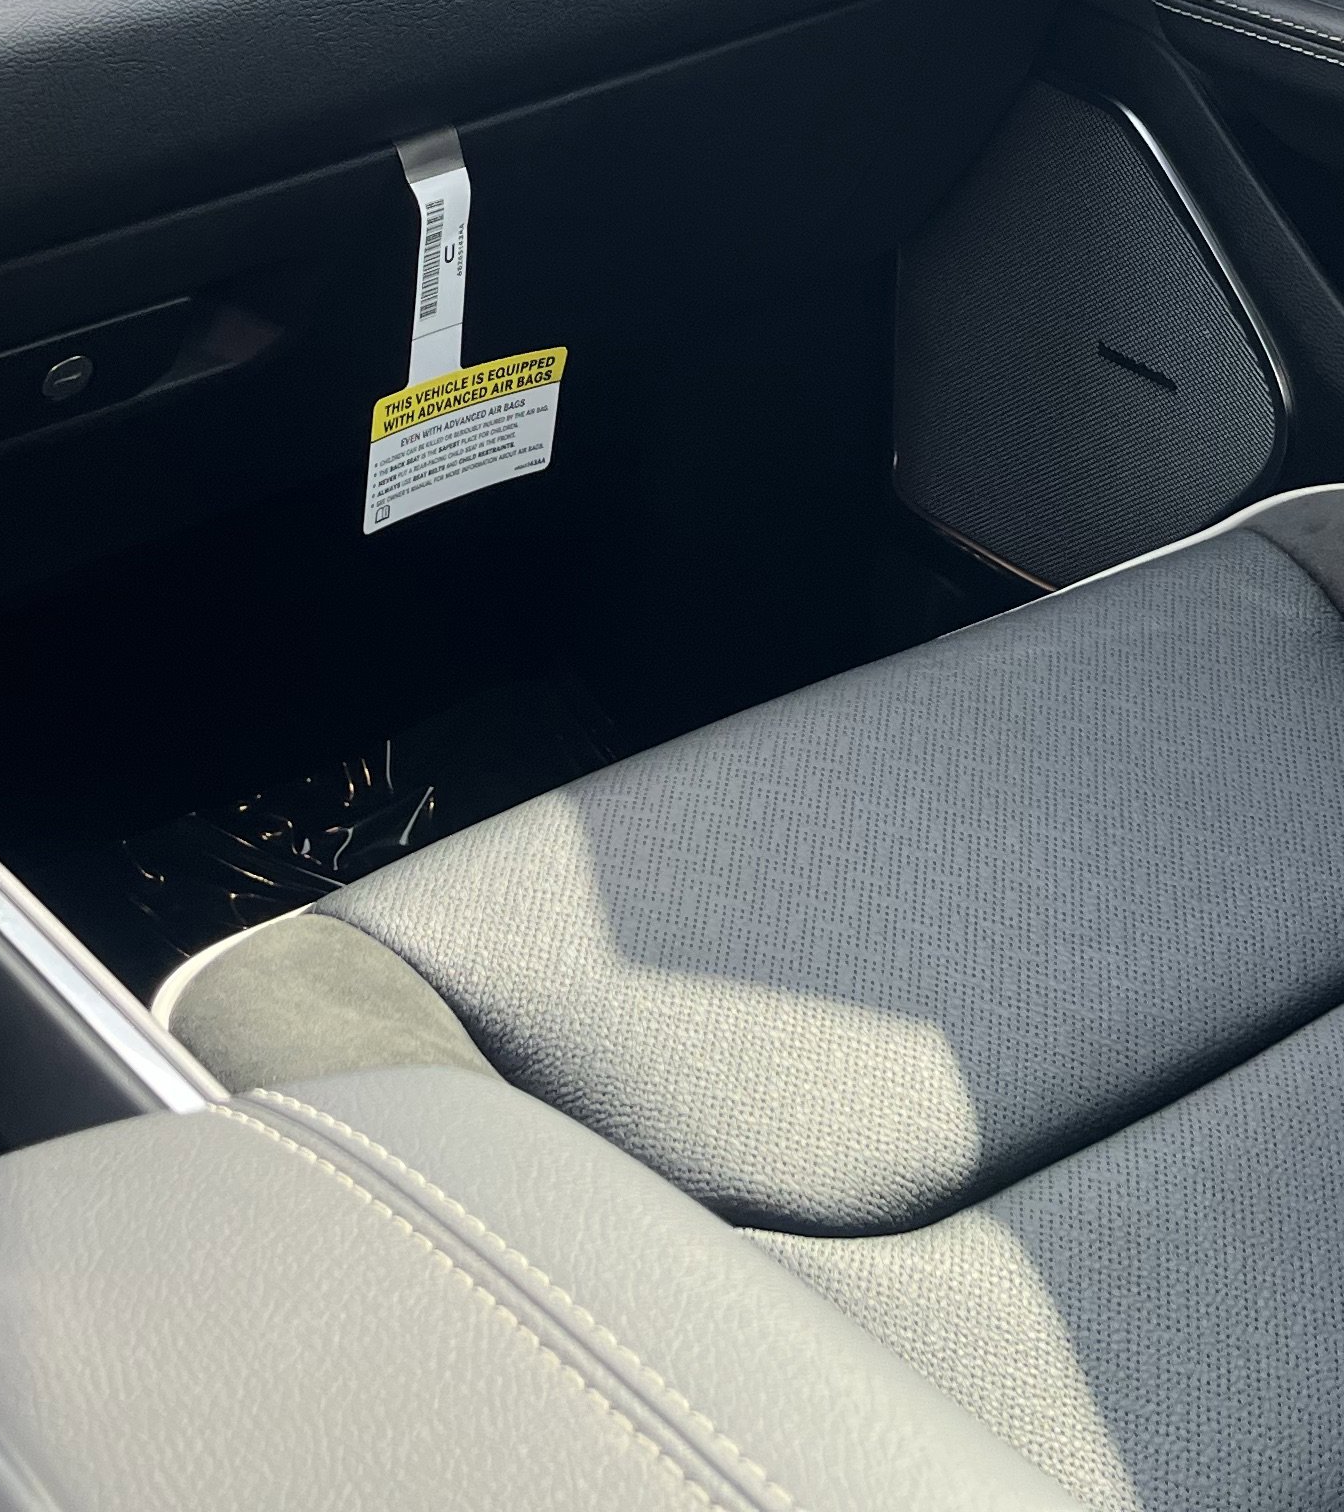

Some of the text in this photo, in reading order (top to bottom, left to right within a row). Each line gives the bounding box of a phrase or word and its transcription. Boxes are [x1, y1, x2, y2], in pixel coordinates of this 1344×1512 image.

[444, 243, 455, 263] U
[384, 369, 553, 433] WITH ADVANCED AIR BAGS
[385, 356, 556, 417] THIS VEHICLE IS EQUIPPED
[400, 398, 526, 448] EVEN WITH ADVANCED AIR BAGS
